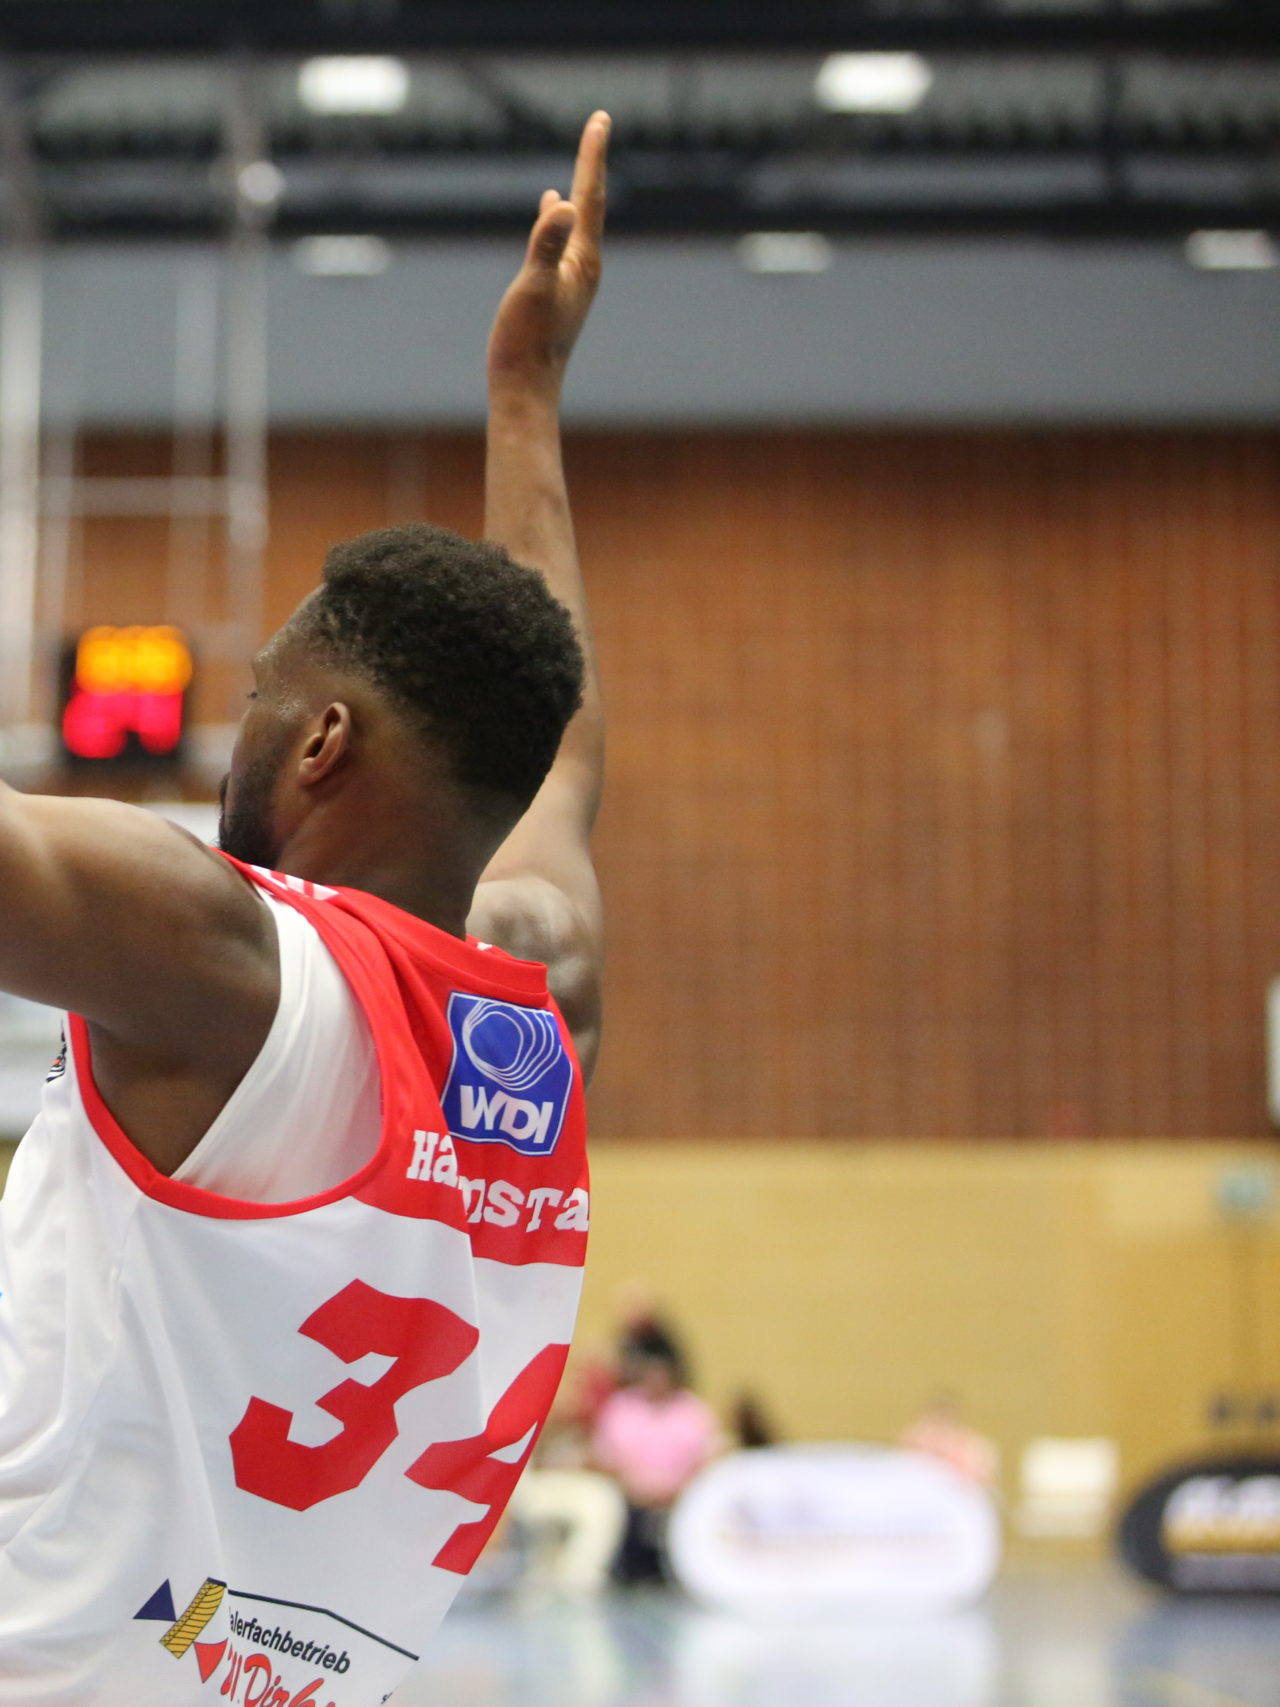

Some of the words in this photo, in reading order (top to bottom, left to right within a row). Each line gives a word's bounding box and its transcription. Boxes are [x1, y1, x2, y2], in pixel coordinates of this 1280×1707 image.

[460, 1085, 553, 1144] WDI
[229, 1278, 570, 1575] 34
[228, 1606, 351, 1674] alerfachbetrieb
